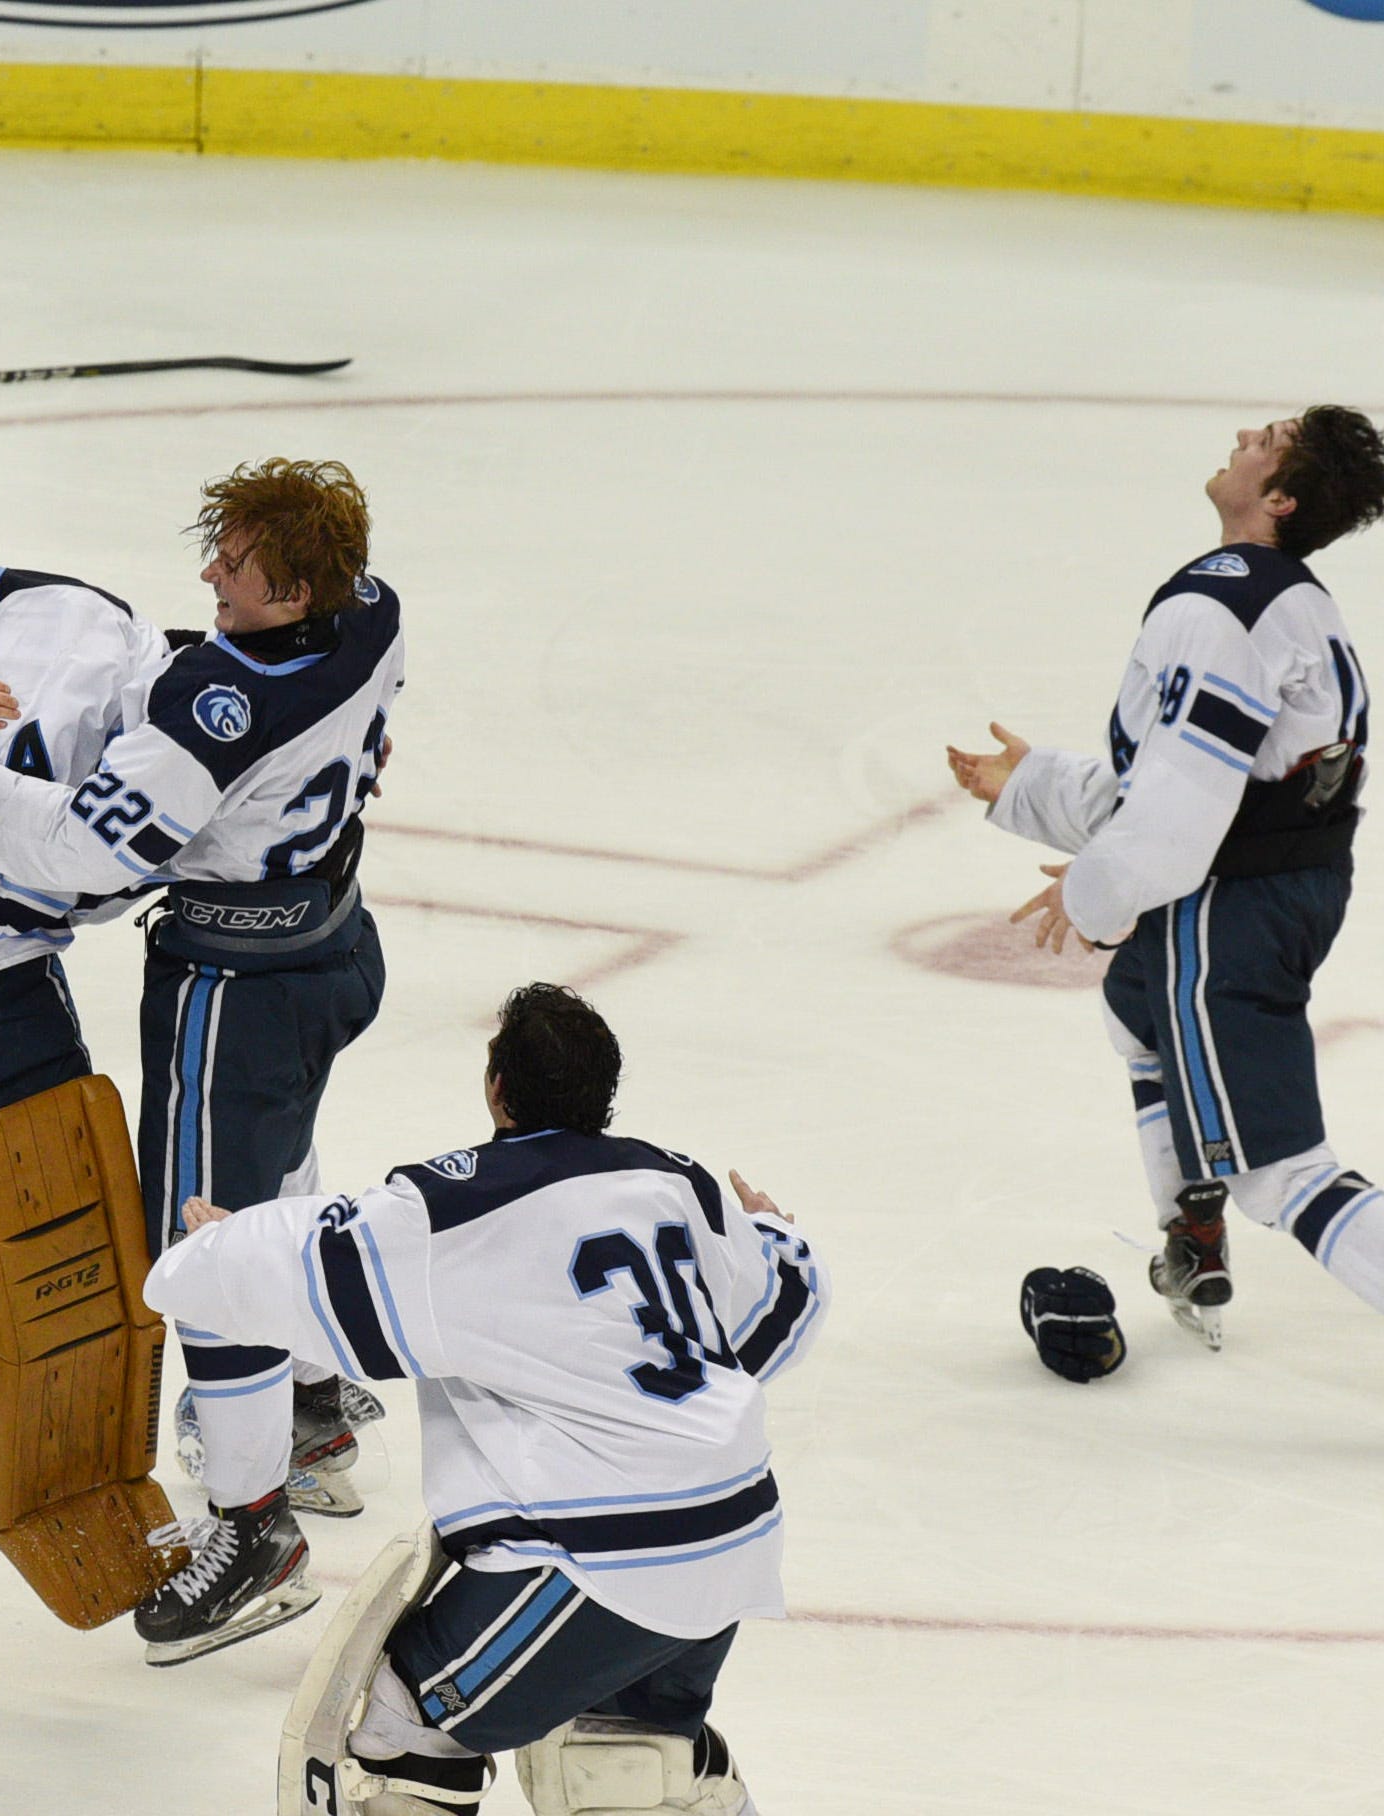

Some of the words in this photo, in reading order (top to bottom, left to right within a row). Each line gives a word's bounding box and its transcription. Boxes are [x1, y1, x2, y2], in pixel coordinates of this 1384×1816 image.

[69, 771, 155, 850] 22
[180, 895, 311, 930] CCM
[567, 1220, 743, 1406] 30
[433, 1682, 467, 1711] PX
